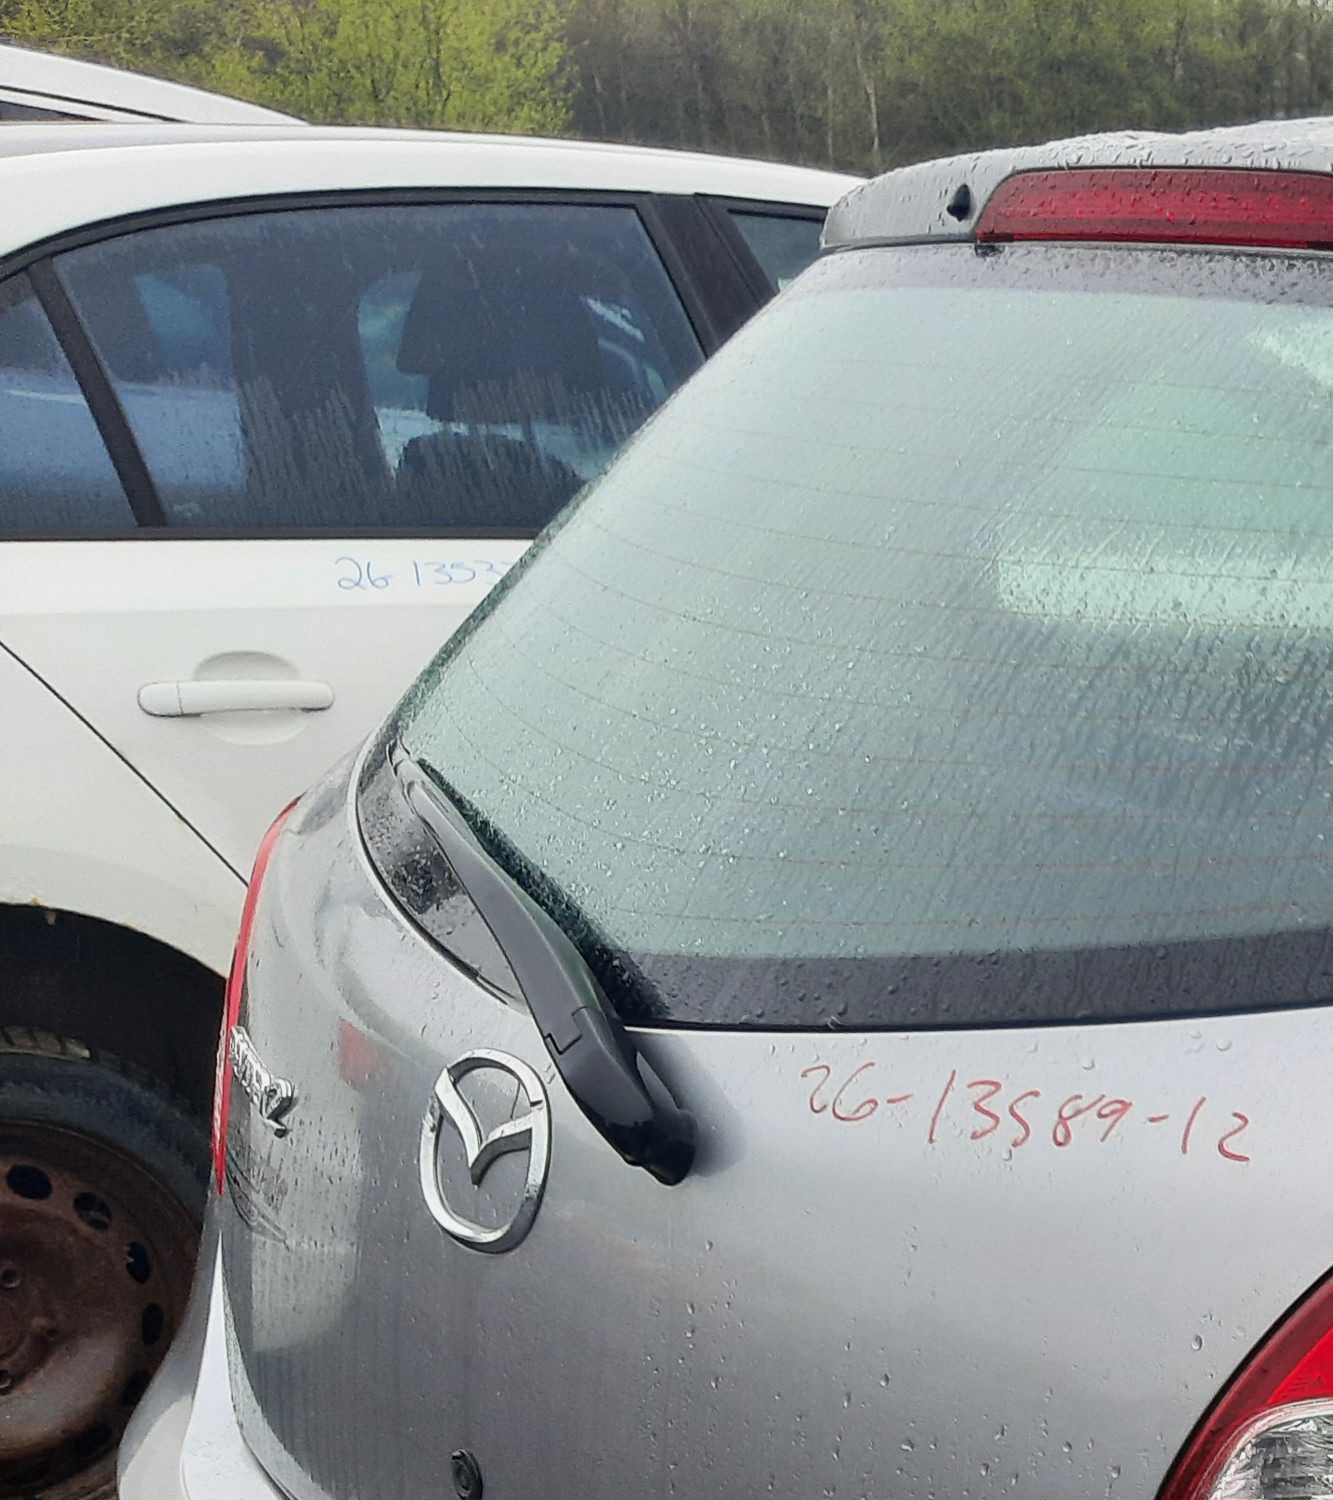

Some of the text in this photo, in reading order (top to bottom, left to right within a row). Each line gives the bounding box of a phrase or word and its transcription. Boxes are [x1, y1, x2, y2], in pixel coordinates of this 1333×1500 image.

[334, 556, 513, 590] 26 1353
[800, 1062, 1251, 1163] 26-13589-12
